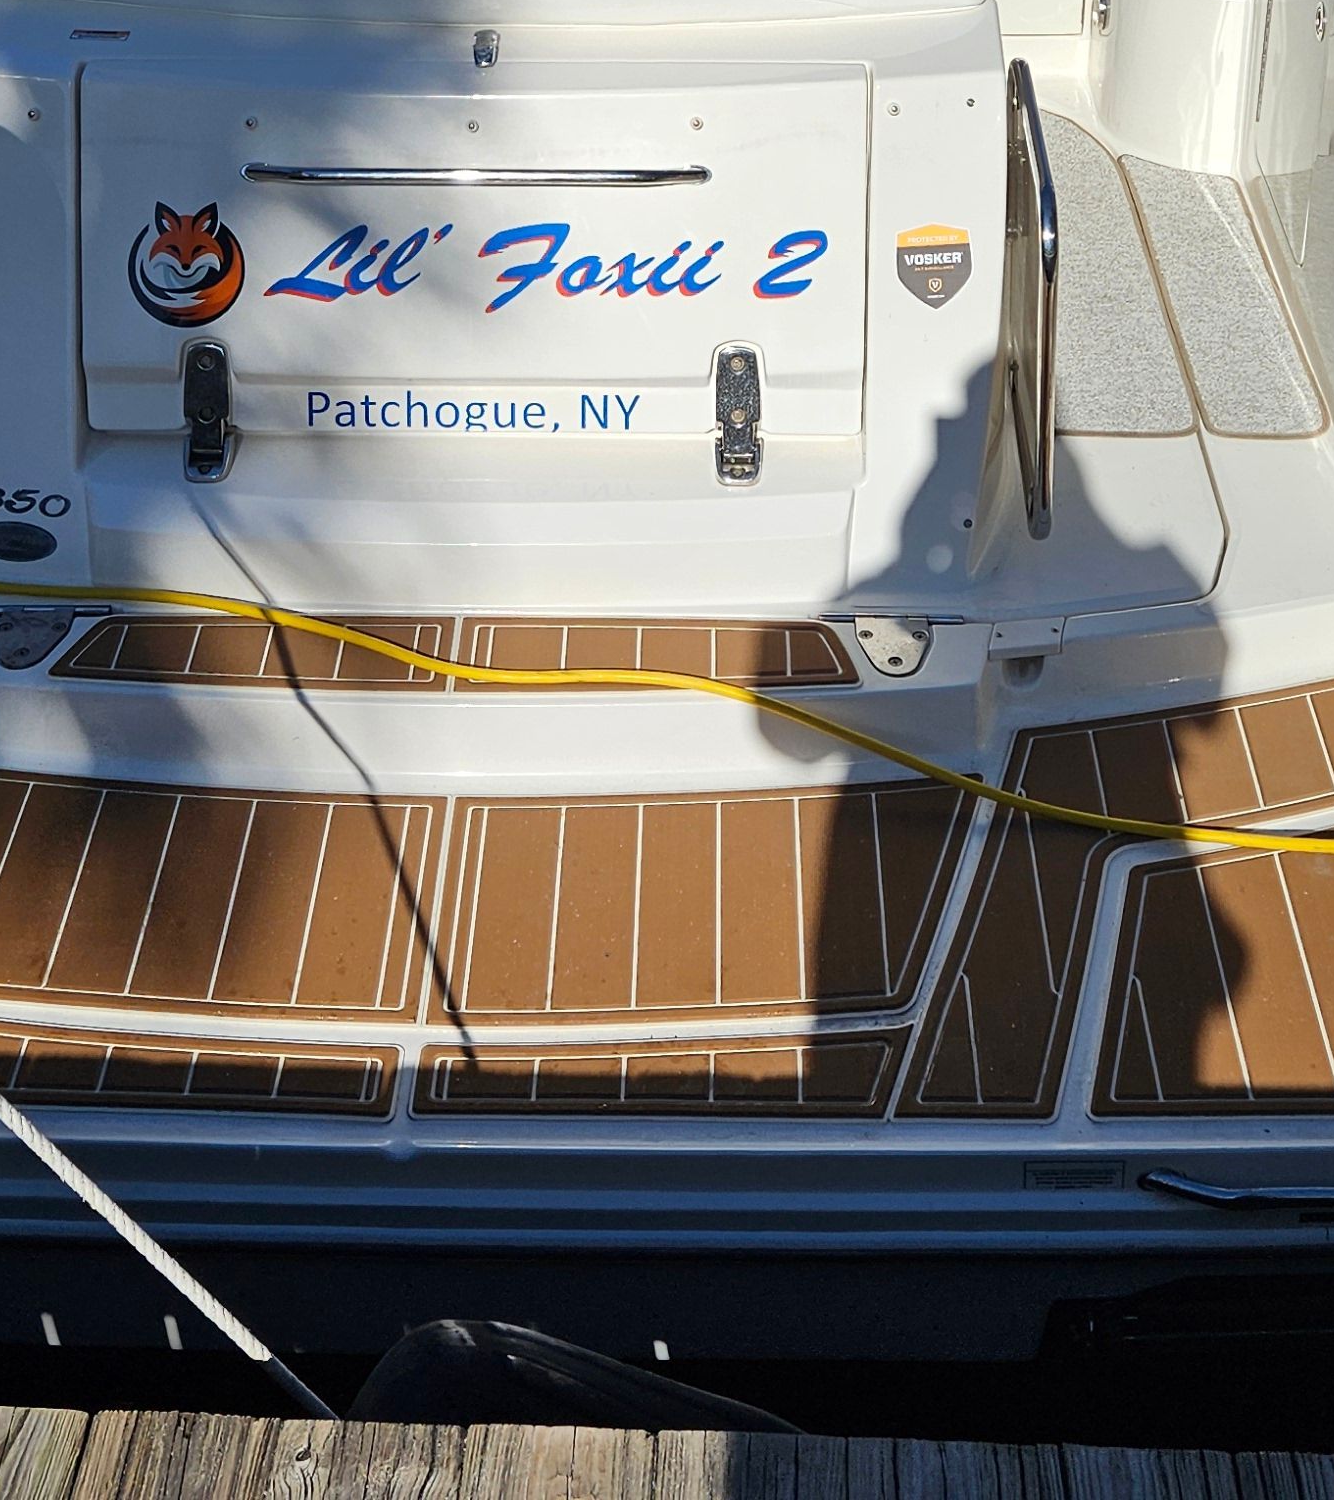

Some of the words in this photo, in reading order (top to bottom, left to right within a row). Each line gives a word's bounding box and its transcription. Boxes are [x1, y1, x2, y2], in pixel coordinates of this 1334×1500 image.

[264, 223, 453, 302] Lil'
[478, 222, 725, 313] Foxii
[753, 230, 828, 299] 2
[308, 390, 560, 432] Patchogue,
[581, 395, 640, 430] NY
